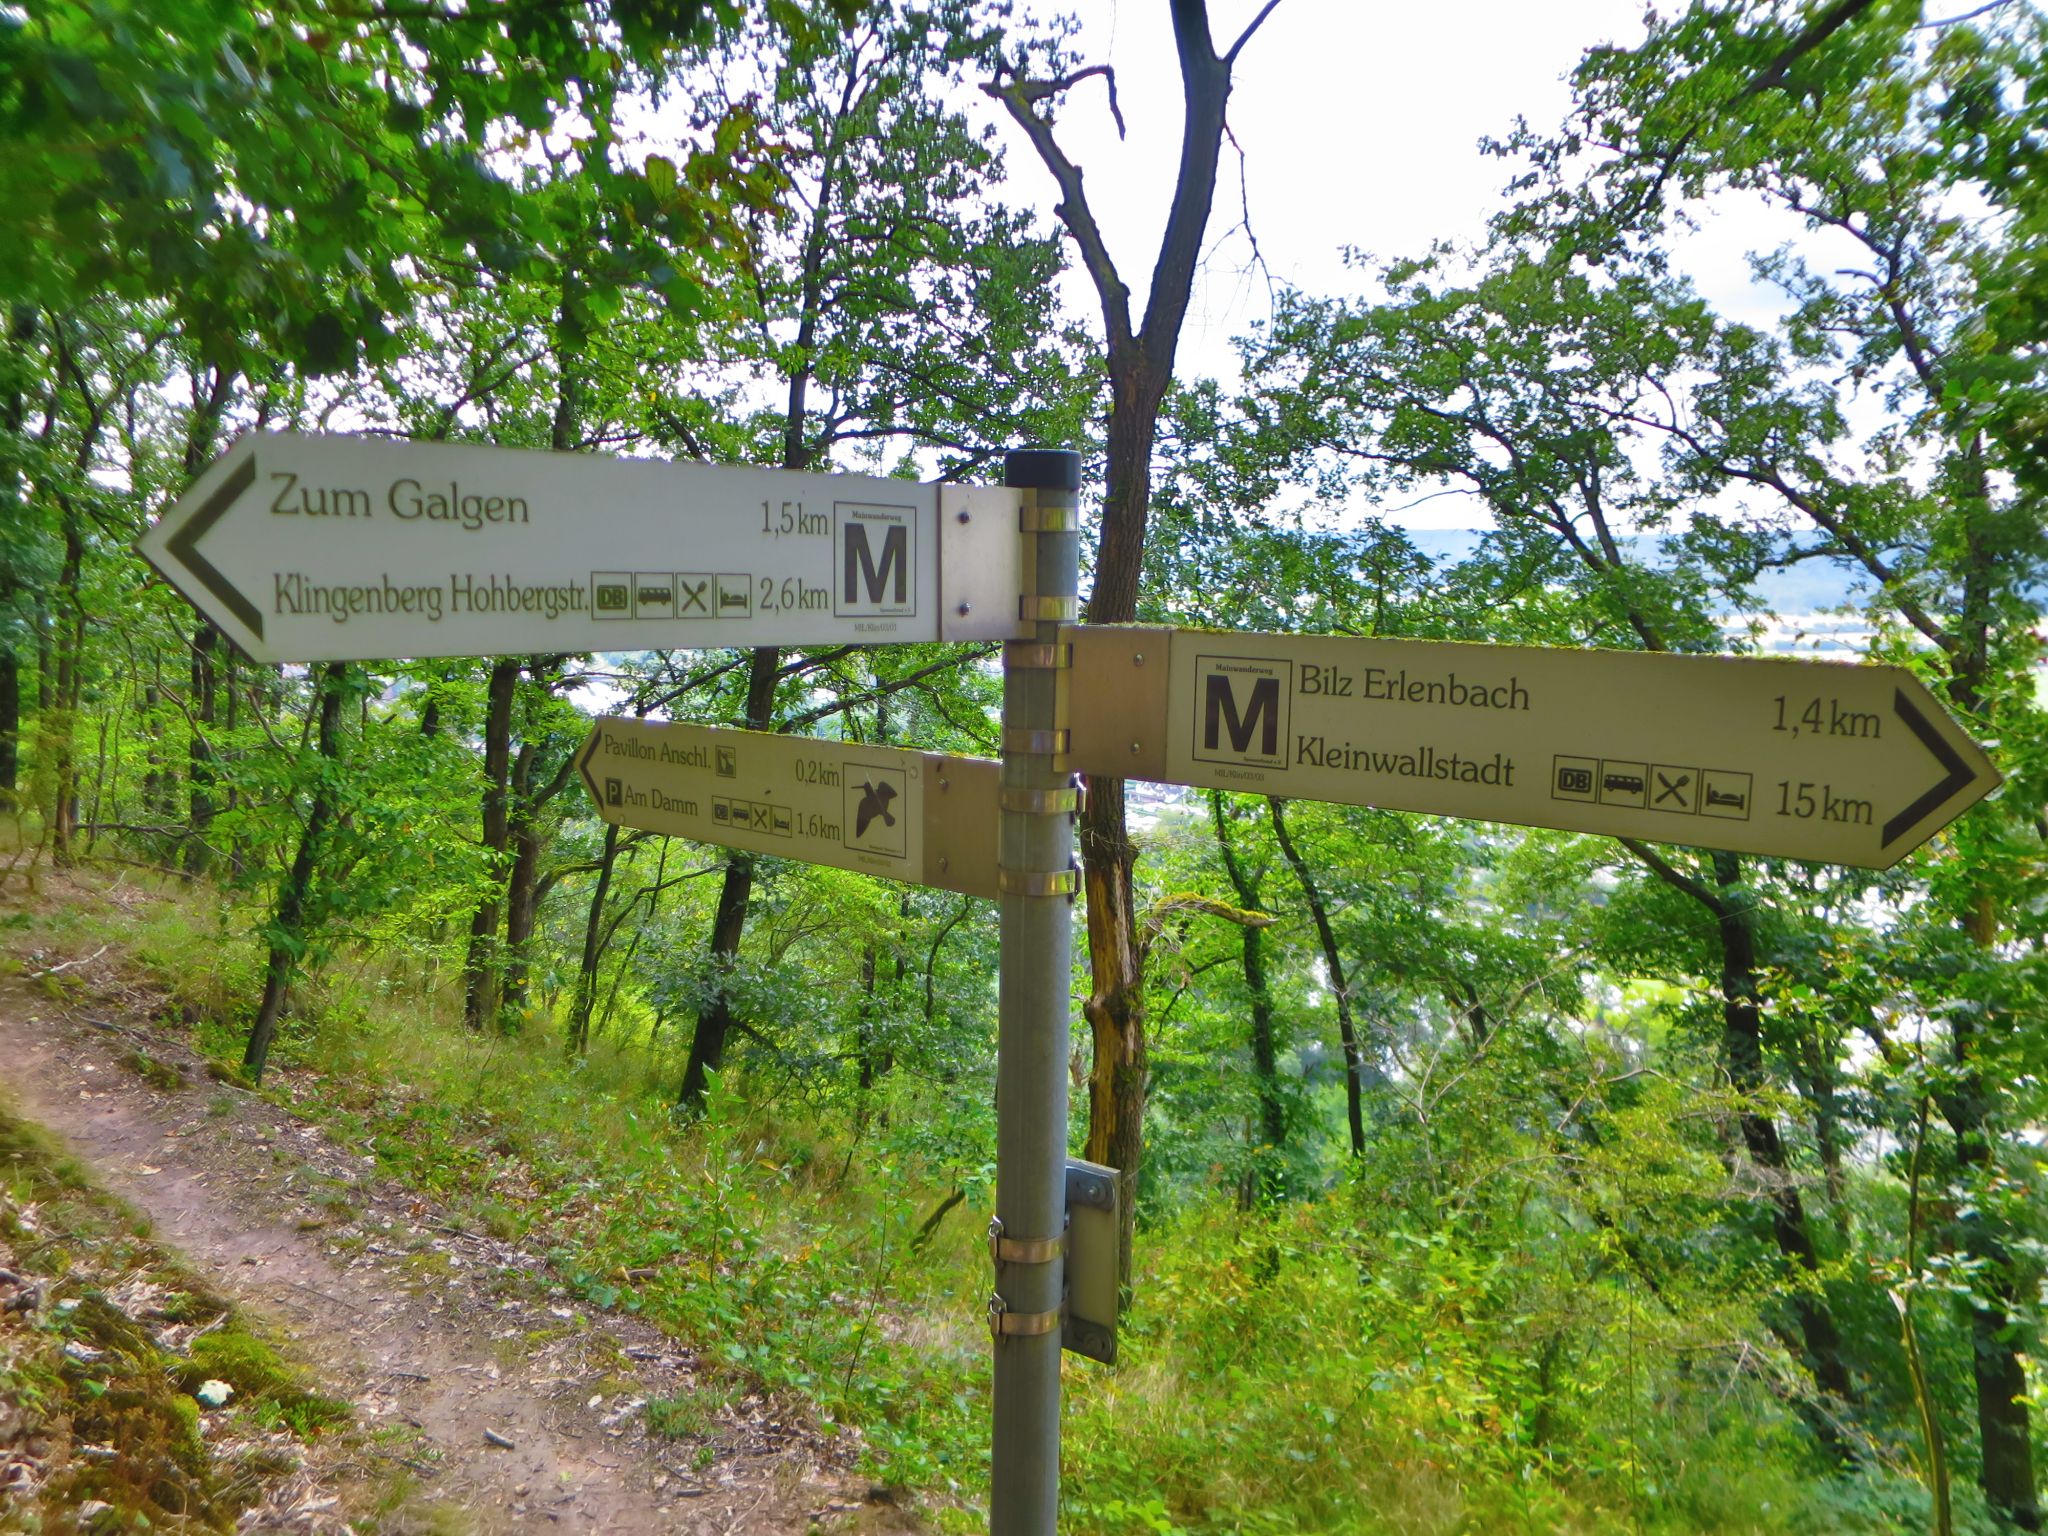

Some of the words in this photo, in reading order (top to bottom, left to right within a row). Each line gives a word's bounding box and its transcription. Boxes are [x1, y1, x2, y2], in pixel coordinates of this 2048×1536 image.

[269, 472, 372, 517] Zum
[387, 477, 530, 530] Galgen
[844, 522, 907, 604] M
[273, 572, 442, 622] Klingenberg
[450, 573, 588, 621] Hohbergstr.
[600, 586, 625, 608] DB
[1215, 663, 1273, 675] Mainwanderweg
[1299, 664, 1353, 697] Bilz
[1363, 668, 1530, 711] Erlenbach
[1204, 674, 1280, 756] M
[604, 734, 656, 761] Pavillon
[660, 742, 711, 769] Anschl.
[1296, 735, 1515, 787] Kleinwallstadt
[624, 784, 648, 807] Am
[651, 788, 698, 816] Damm
[1561, 770, 1589, 791] DB
